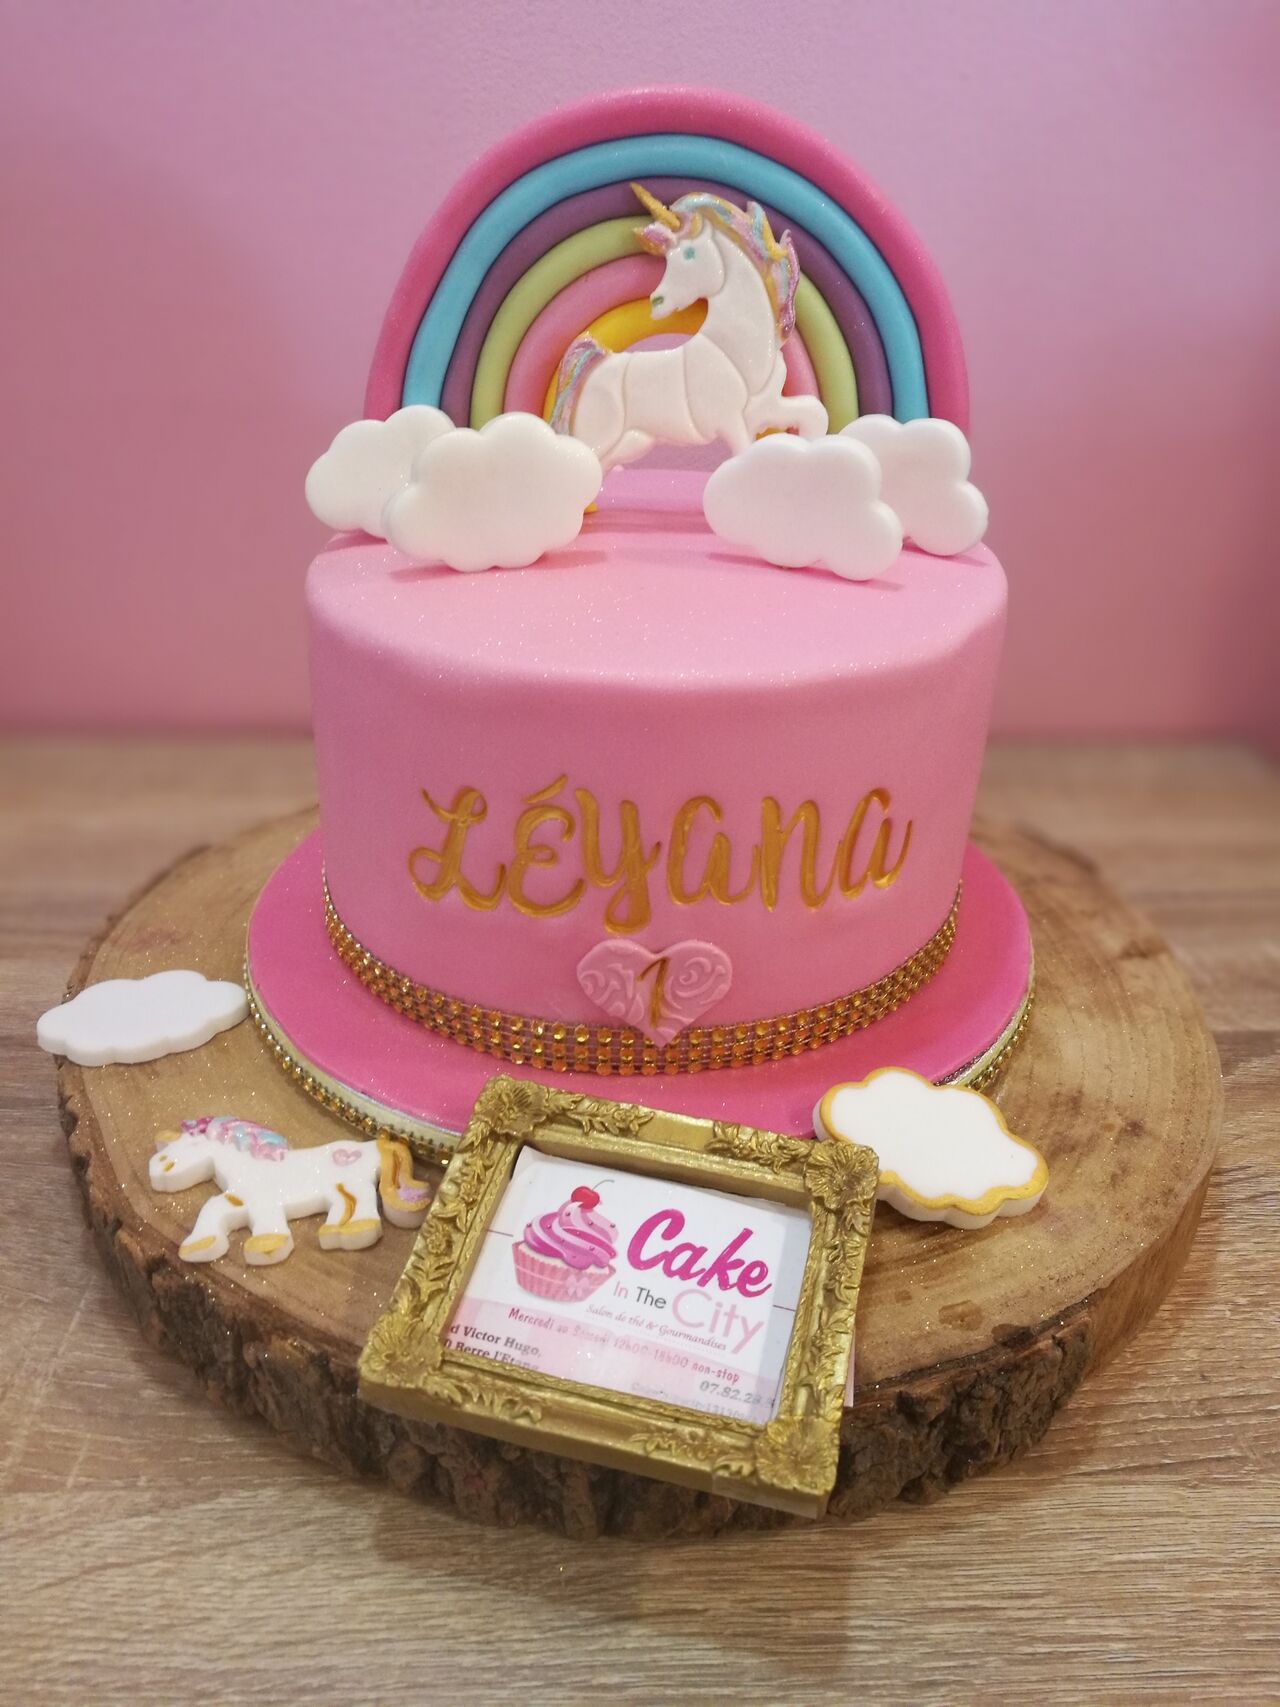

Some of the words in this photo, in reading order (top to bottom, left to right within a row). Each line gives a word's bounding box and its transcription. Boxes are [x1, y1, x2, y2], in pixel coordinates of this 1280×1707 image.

[636, 957, 671, 1029] 1
[627, 1208, 772, 1298] Cake
[463, 1325, 501, 1345] Victor
[508, 1307, 554, 1331] Mercredi
[613, 1281, 629, 1300] In
[636, 1286, 667, 1310] The
[672, 1288, 765, 1355] City
[659, 1324, 727, 1351] Gourmandises
